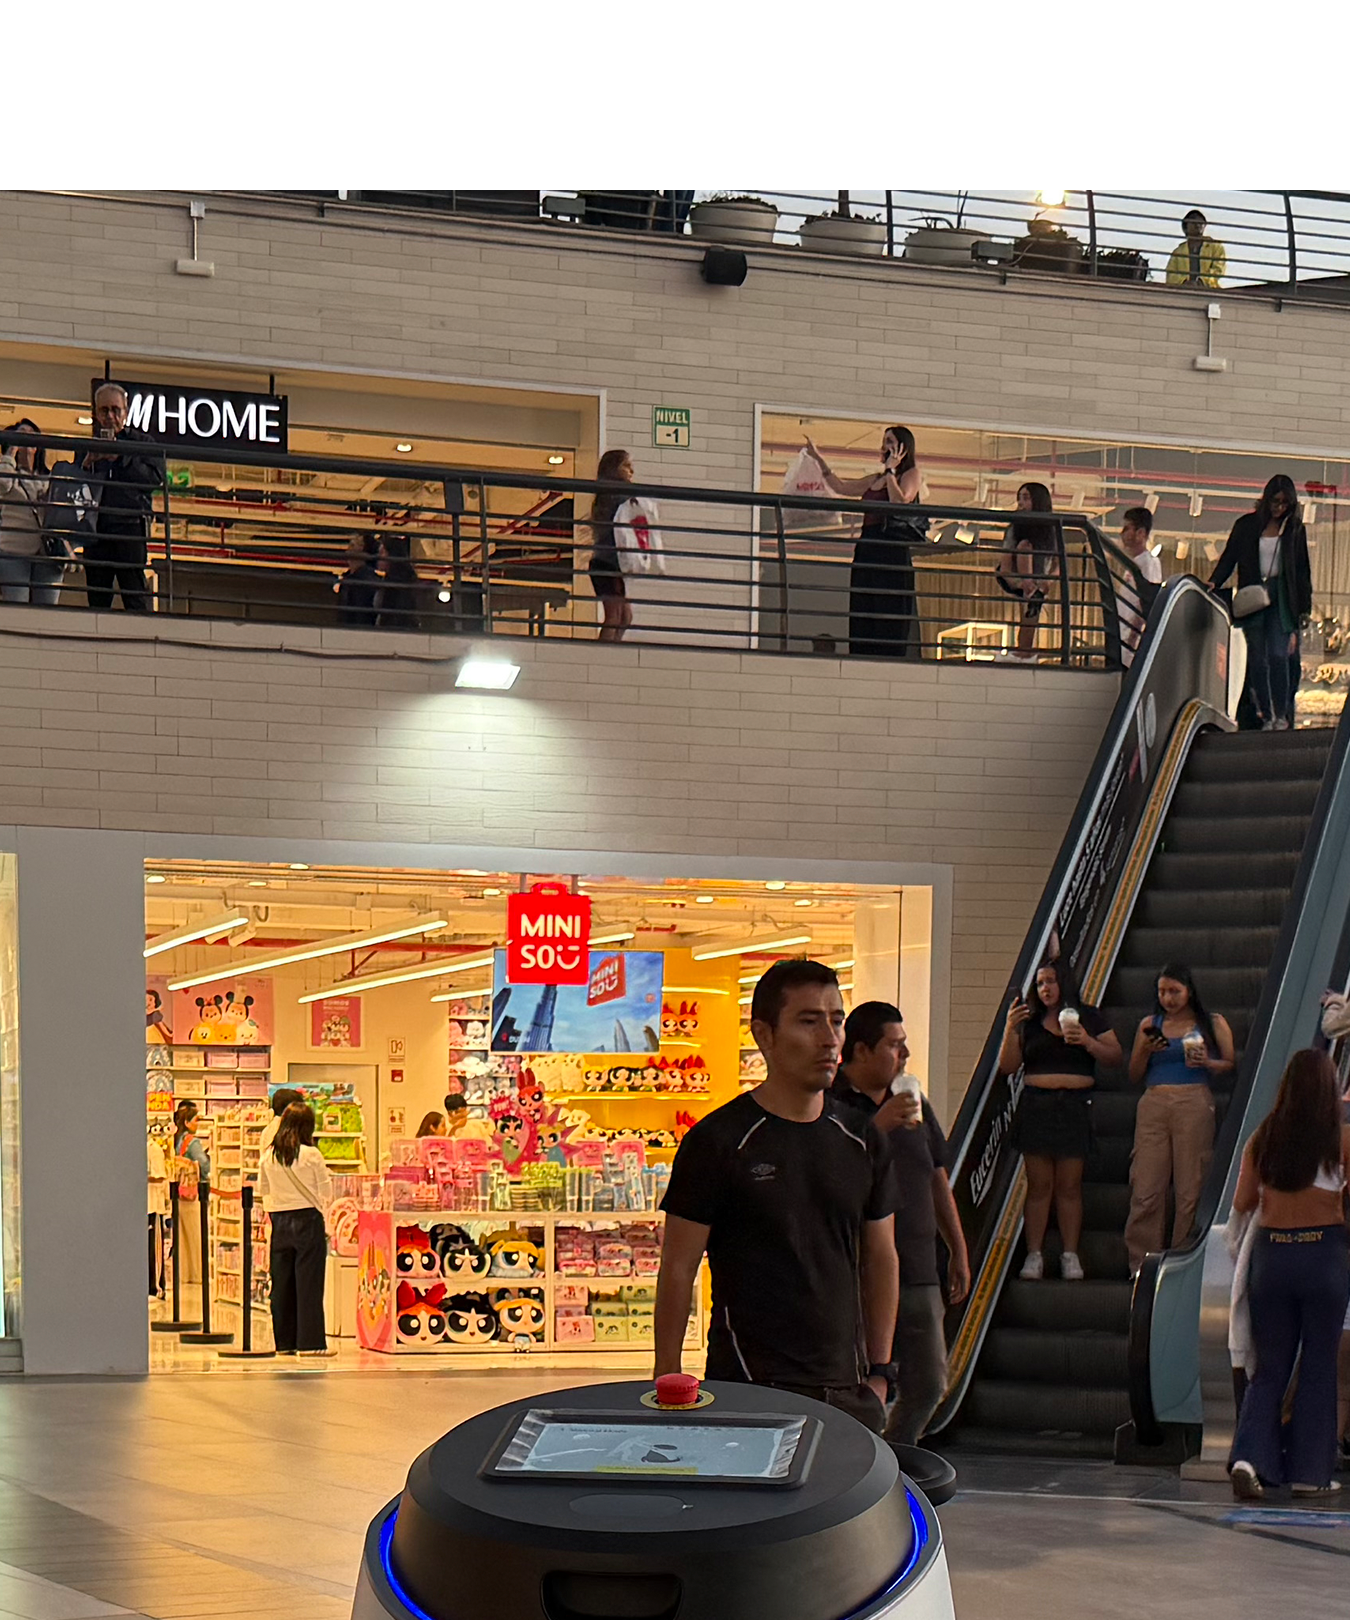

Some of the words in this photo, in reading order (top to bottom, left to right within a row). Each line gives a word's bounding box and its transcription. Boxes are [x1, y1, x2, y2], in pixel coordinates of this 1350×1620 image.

[158, 395, 280, 443] HOME
[656, 410, 688, 424] NIVEL
[666, 428, 678, 443] -1
[520, 913, 581, 938] MINI
[970, 1115, 1002, 1204] Eucerin
